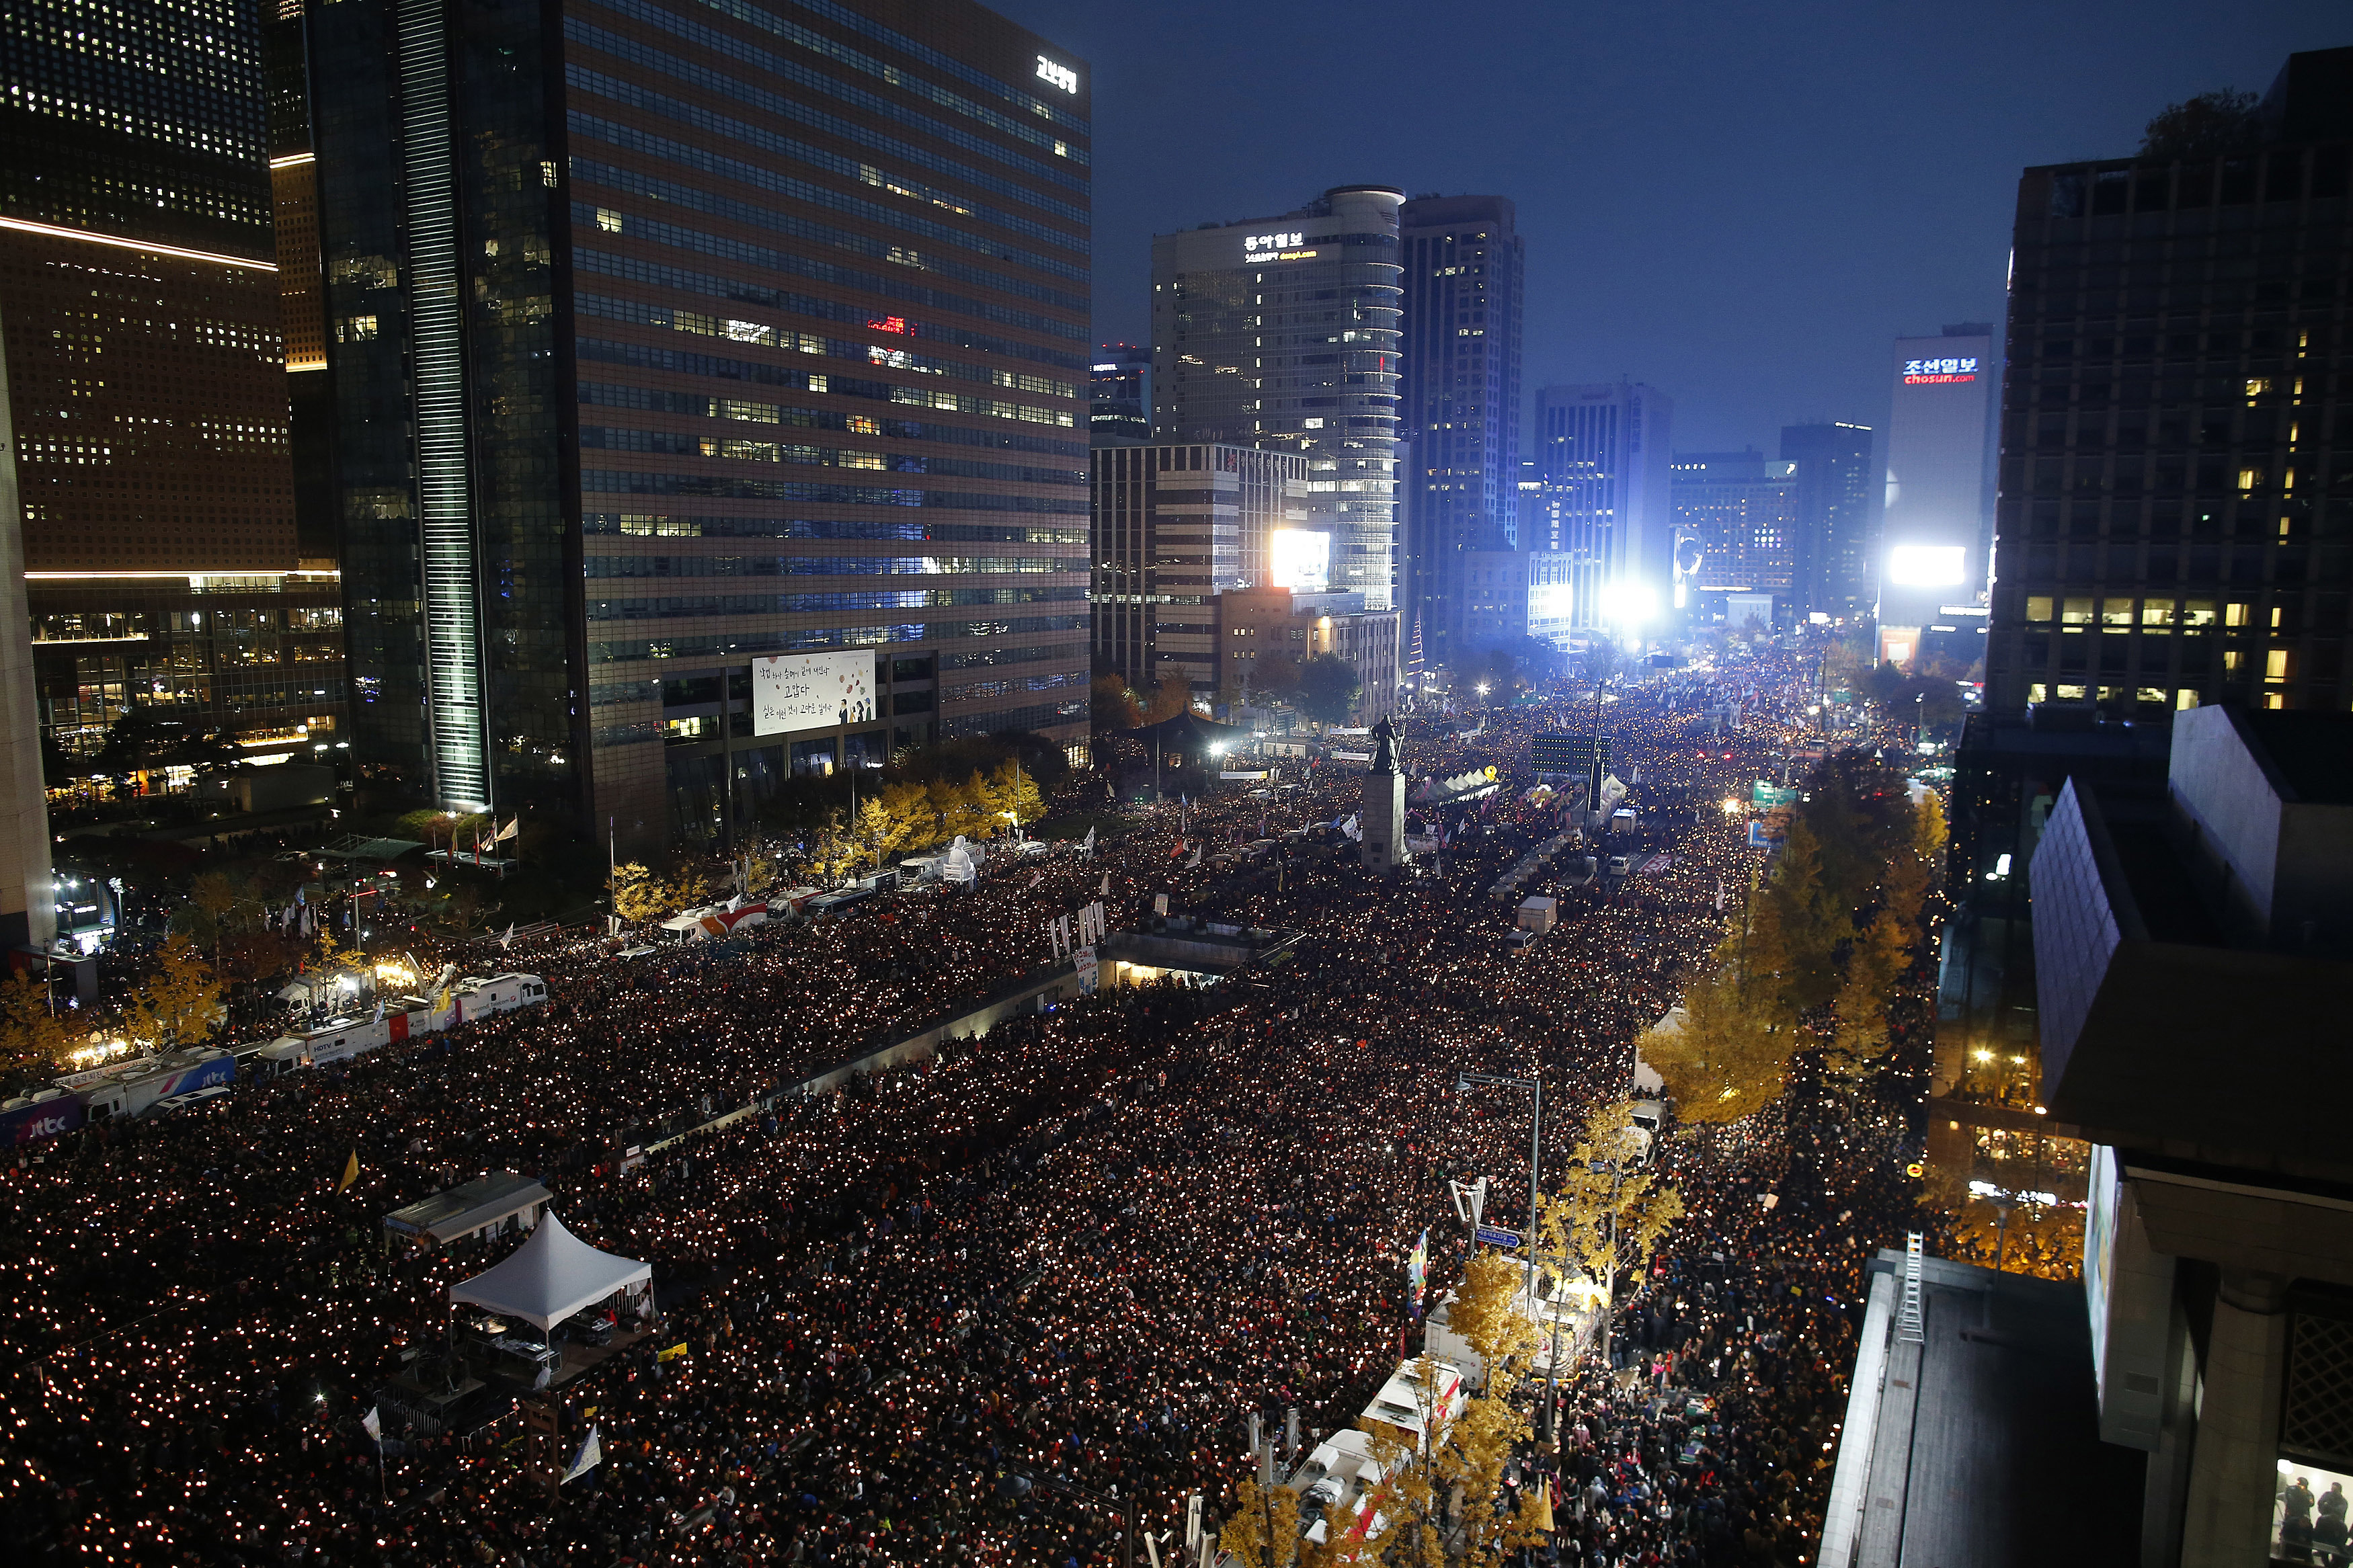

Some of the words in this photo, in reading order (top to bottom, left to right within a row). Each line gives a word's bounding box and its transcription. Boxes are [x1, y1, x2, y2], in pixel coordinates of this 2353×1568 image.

[1035, 54, 1077, 95] 교보생명
[1244, 232, 1304, 251] 동아일보
[1903, 357, 1979, 375] 조선일보
[1904, 374, 1975, 384] chosun.com
[760, 667, 770, 679] 낙엽
[772, 671, 782, 679] 하나
[813, 665, 830, 676] 내린다
[784, 683, 810, 698] 고맙다
[763, 704, 774, 719] 실은
[776, 708, 787, 720] 이런
[787, 704, 798, 715] 것이
[818, 703, 832, 715] 일이다
[314, 1042, 331, 1053] HDTV
[74, 1074, 87, 1083] 즉각
[89, 1070, 102, 1079] 퇴진
[201, 1071, 226, 1087] jtbc
[31, 1115, 66, 1138] jtbc
